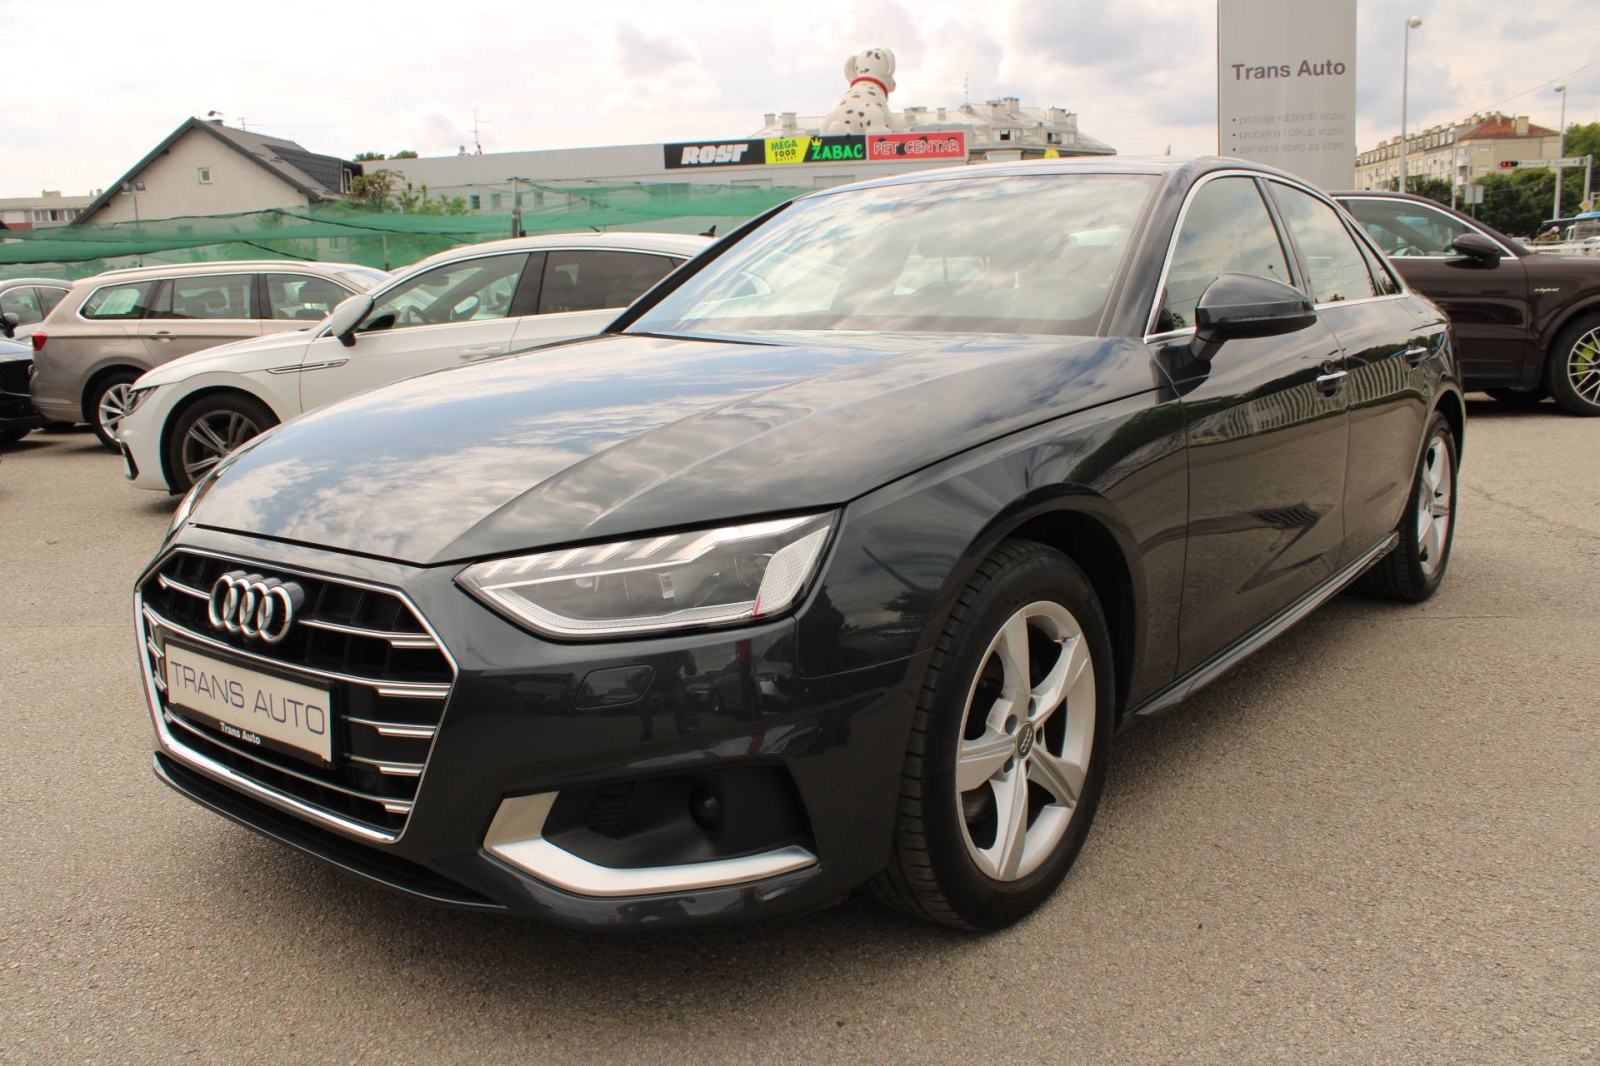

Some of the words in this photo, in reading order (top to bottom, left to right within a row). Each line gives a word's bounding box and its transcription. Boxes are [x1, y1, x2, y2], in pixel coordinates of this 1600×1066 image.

[1232, 64, 1291, 80] Trans
[1297, 60, 1345, 77] Auto
[771, 139, 798, 151] MEGA
[775, 148, 796, 158] FOOD
[874, 141, 899, 155] PET
[904, 139, 959, 154] CENTAR
[170, 660, 245, 709] TRANS
[253, 689, 325, 735] AUTO
[220, 721, 241, 738] Trans
[242, 730, 261, 745] Auto
